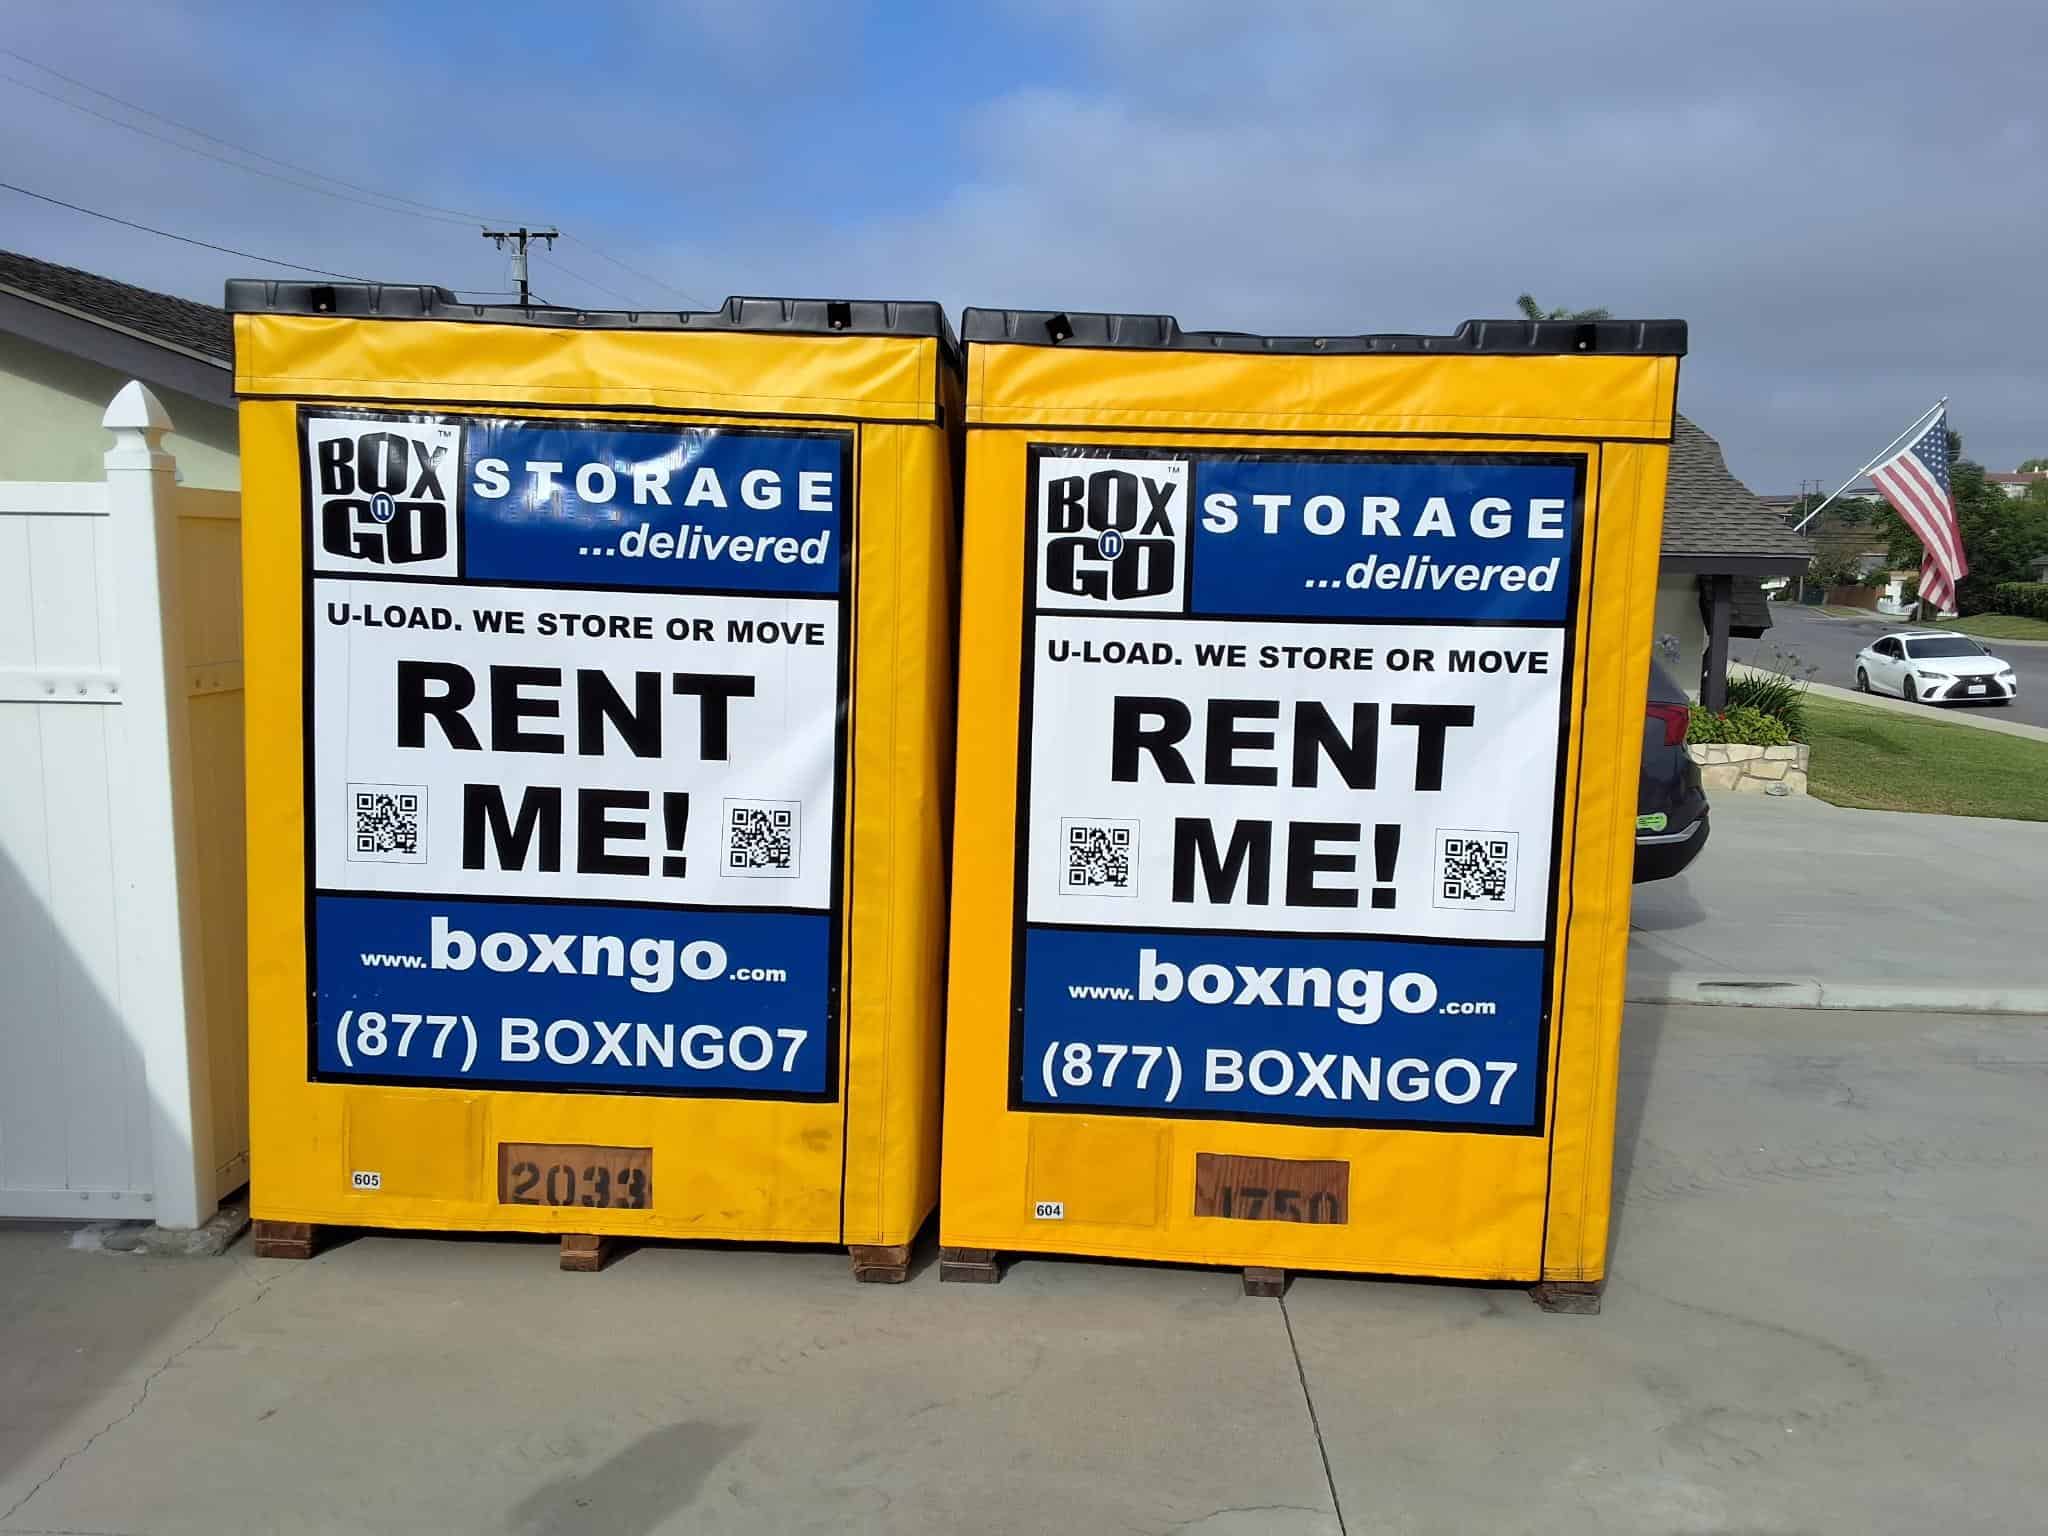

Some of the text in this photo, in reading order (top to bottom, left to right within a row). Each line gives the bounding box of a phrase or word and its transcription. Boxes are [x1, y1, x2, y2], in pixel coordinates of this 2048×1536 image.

[318, 432, 448, 500] BOX
[473, 458, 833, 511] STORAGE
[322, 499, 447, 564] GO
[377, 499, 389, 516] n
[1048, 470, 1177, 536] BOX
[1203, 494, 1564, 538] STORAGE
[580, 523, 830, 563] ...delivered
[1047, 537, 1175, 600] GO
[1105, 536, 1117, 553] n
[1306, 555, 1560, 591] ...delivered
[328, 603, 824, 645] U-LOAD. WE STORE OR MOVE
[1049, 640, 1548, 673] U-LOAD. WE STORE OR MOVE
[398, 661, 755, 760] RENT
[1112, 696, 1475, 791] RENT
[463, 784, 689, 878] ME!
[1173, 818, 1400, 909] ME!
[361, 917, 785, 992] www.boxngo.com
[1069, 949, 1495, 1024] www.boxngo.com
[338, 1011, 807, 1072] (877) BOXNGO7
[1043, 1042, 1517, 1104] (877) BOXNGO7
[354, 1174, 378, 1186] 605
[512, 1162, 646, 1208] 2033
[1037, 1204, 1060, 1216] 604
